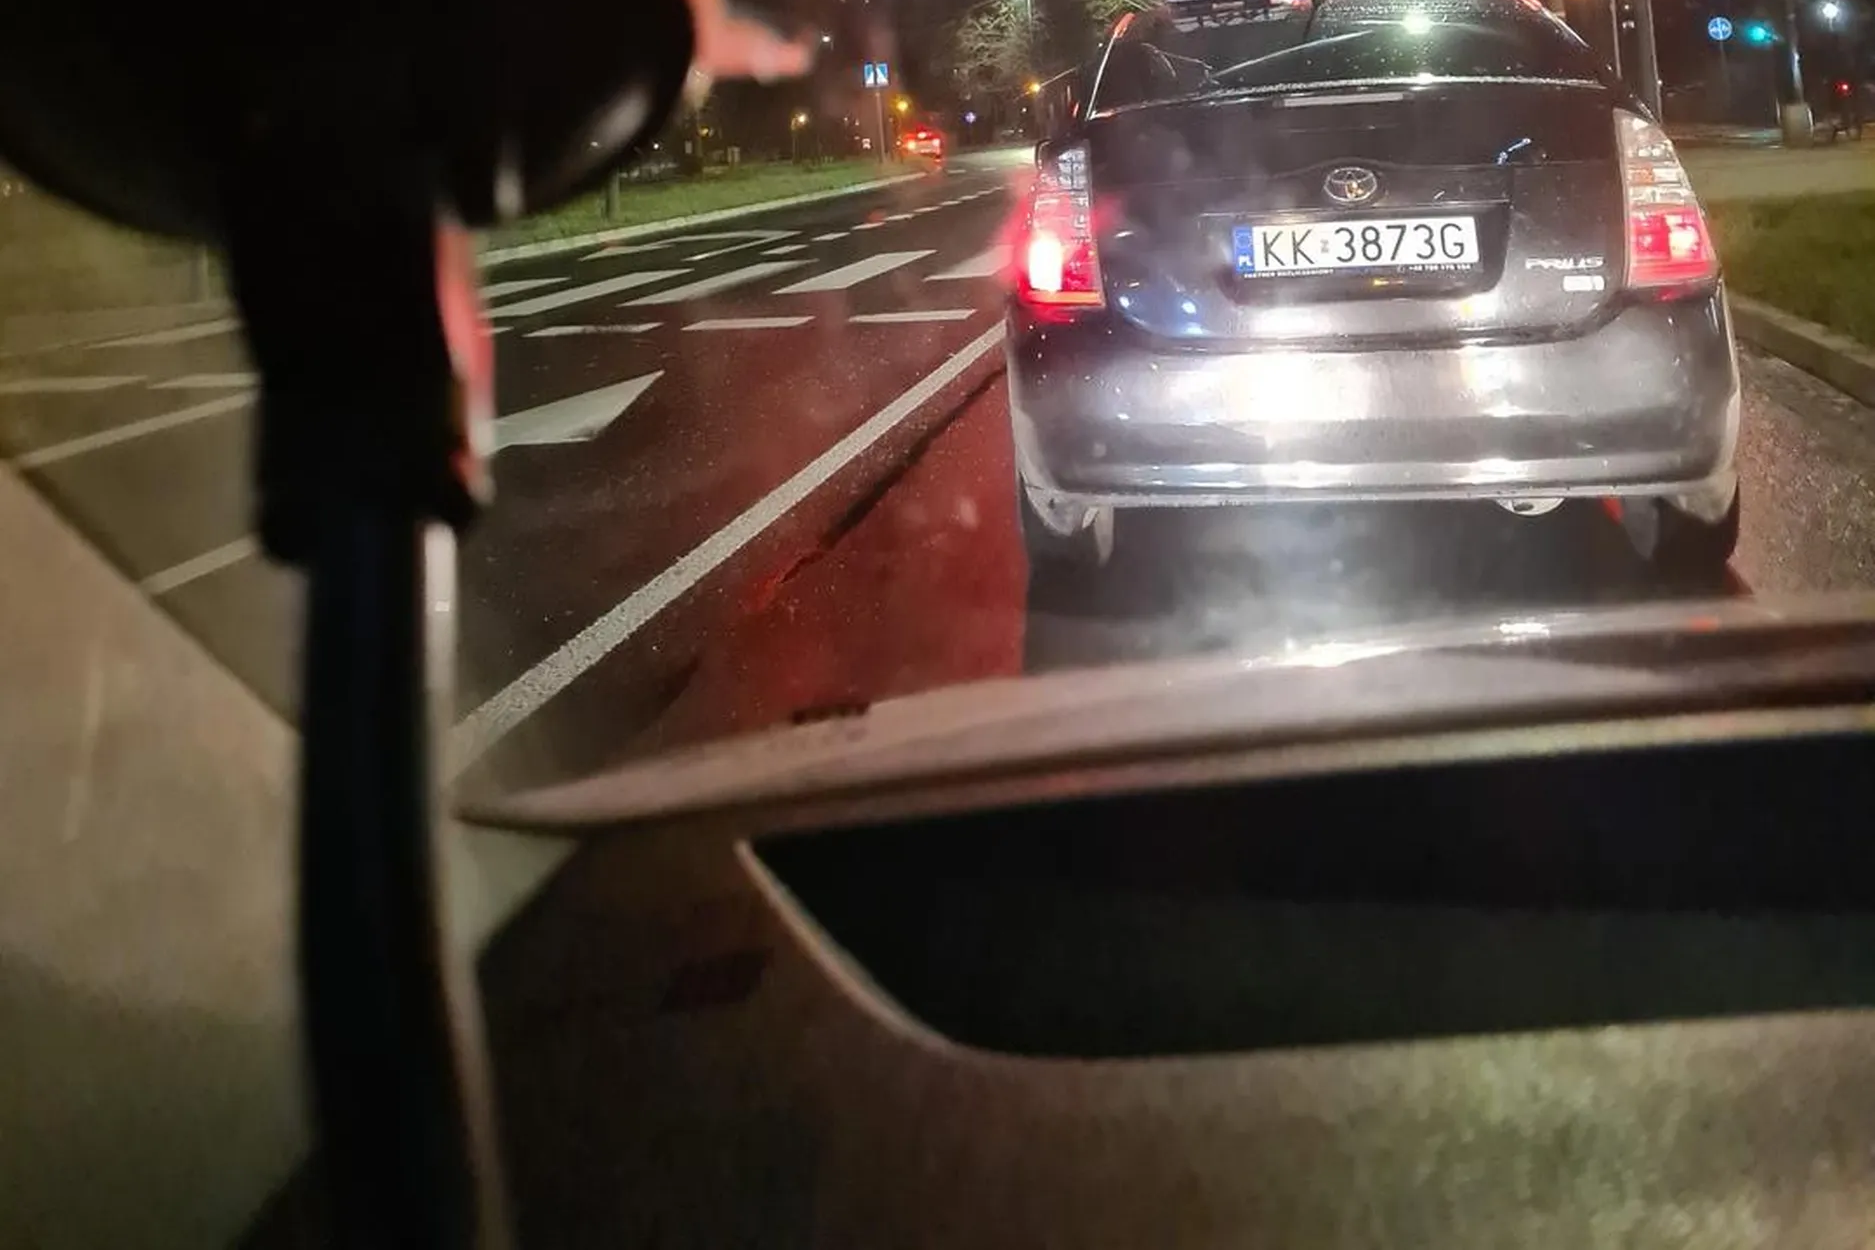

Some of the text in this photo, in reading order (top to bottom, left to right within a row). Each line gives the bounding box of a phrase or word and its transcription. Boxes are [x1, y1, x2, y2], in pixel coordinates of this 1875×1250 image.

[1262, 223, 1465, 267] KK 3873G
[1239, 255, 1252, 267] PL
